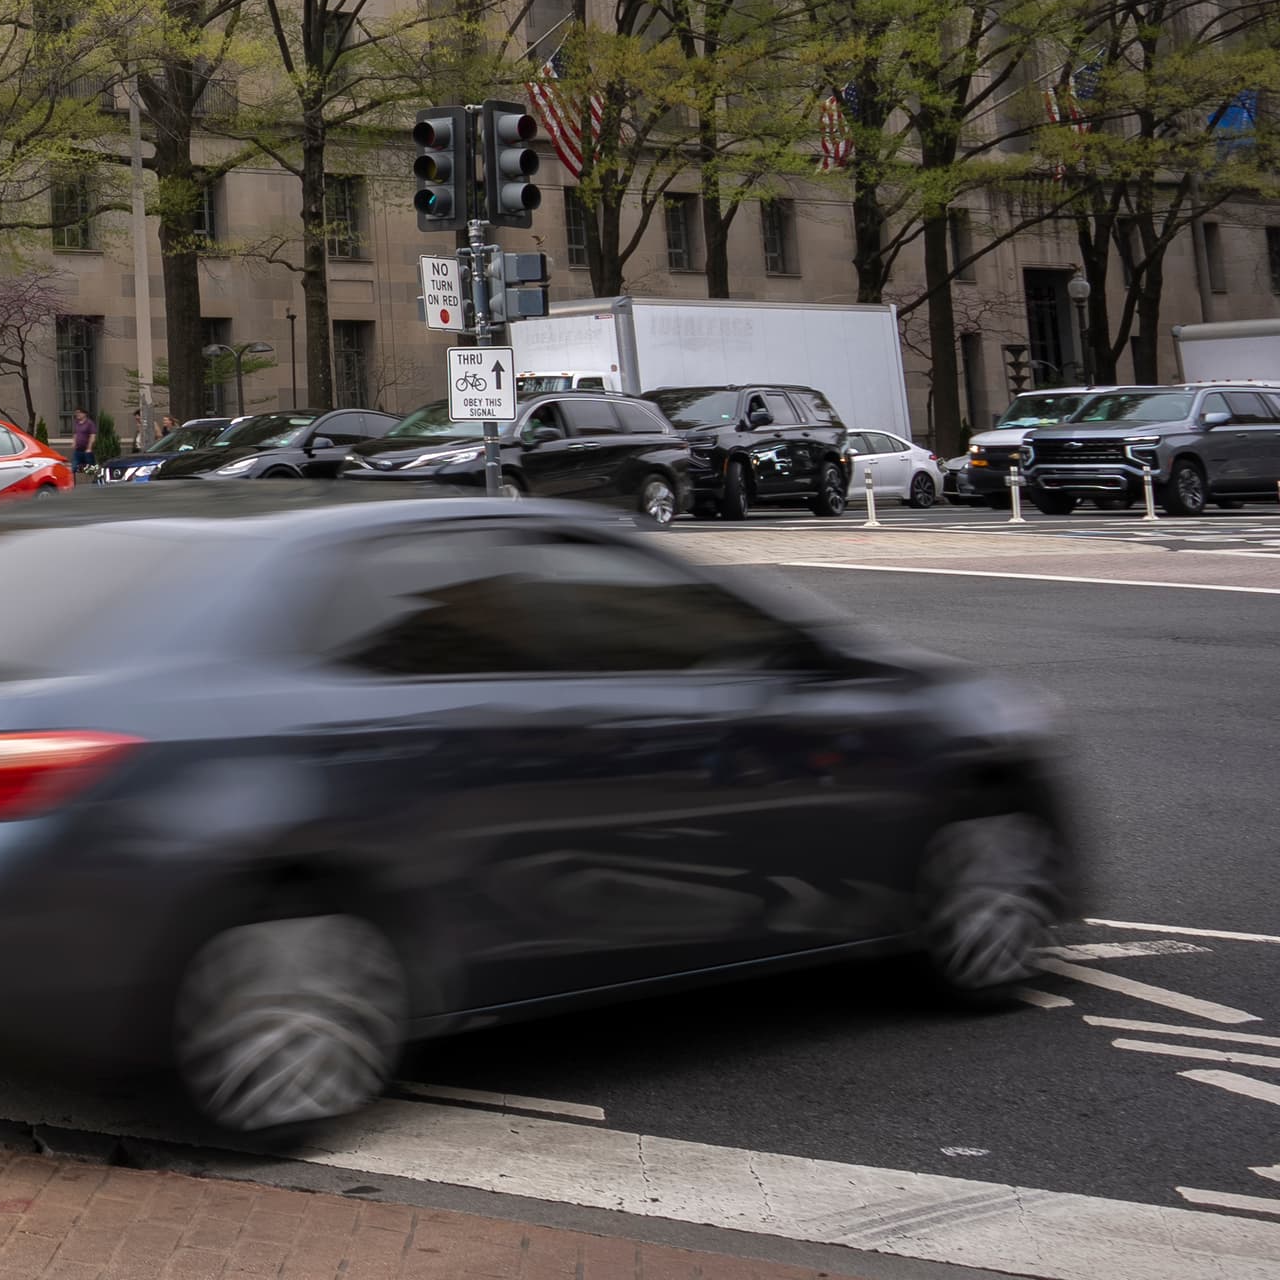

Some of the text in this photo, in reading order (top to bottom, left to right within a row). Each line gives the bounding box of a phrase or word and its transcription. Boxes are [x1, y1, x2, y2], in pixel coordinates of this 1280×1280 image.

[431, 262, 449, 277] NO
[431, 279, 453, 292] TURN
[427, 294, 459, 307] ON RED
[457, 353, 483, 365] THRU
[463, 398, 502, 407] OBEY THIS
[469, 407, 497, 417] SIGNAL
